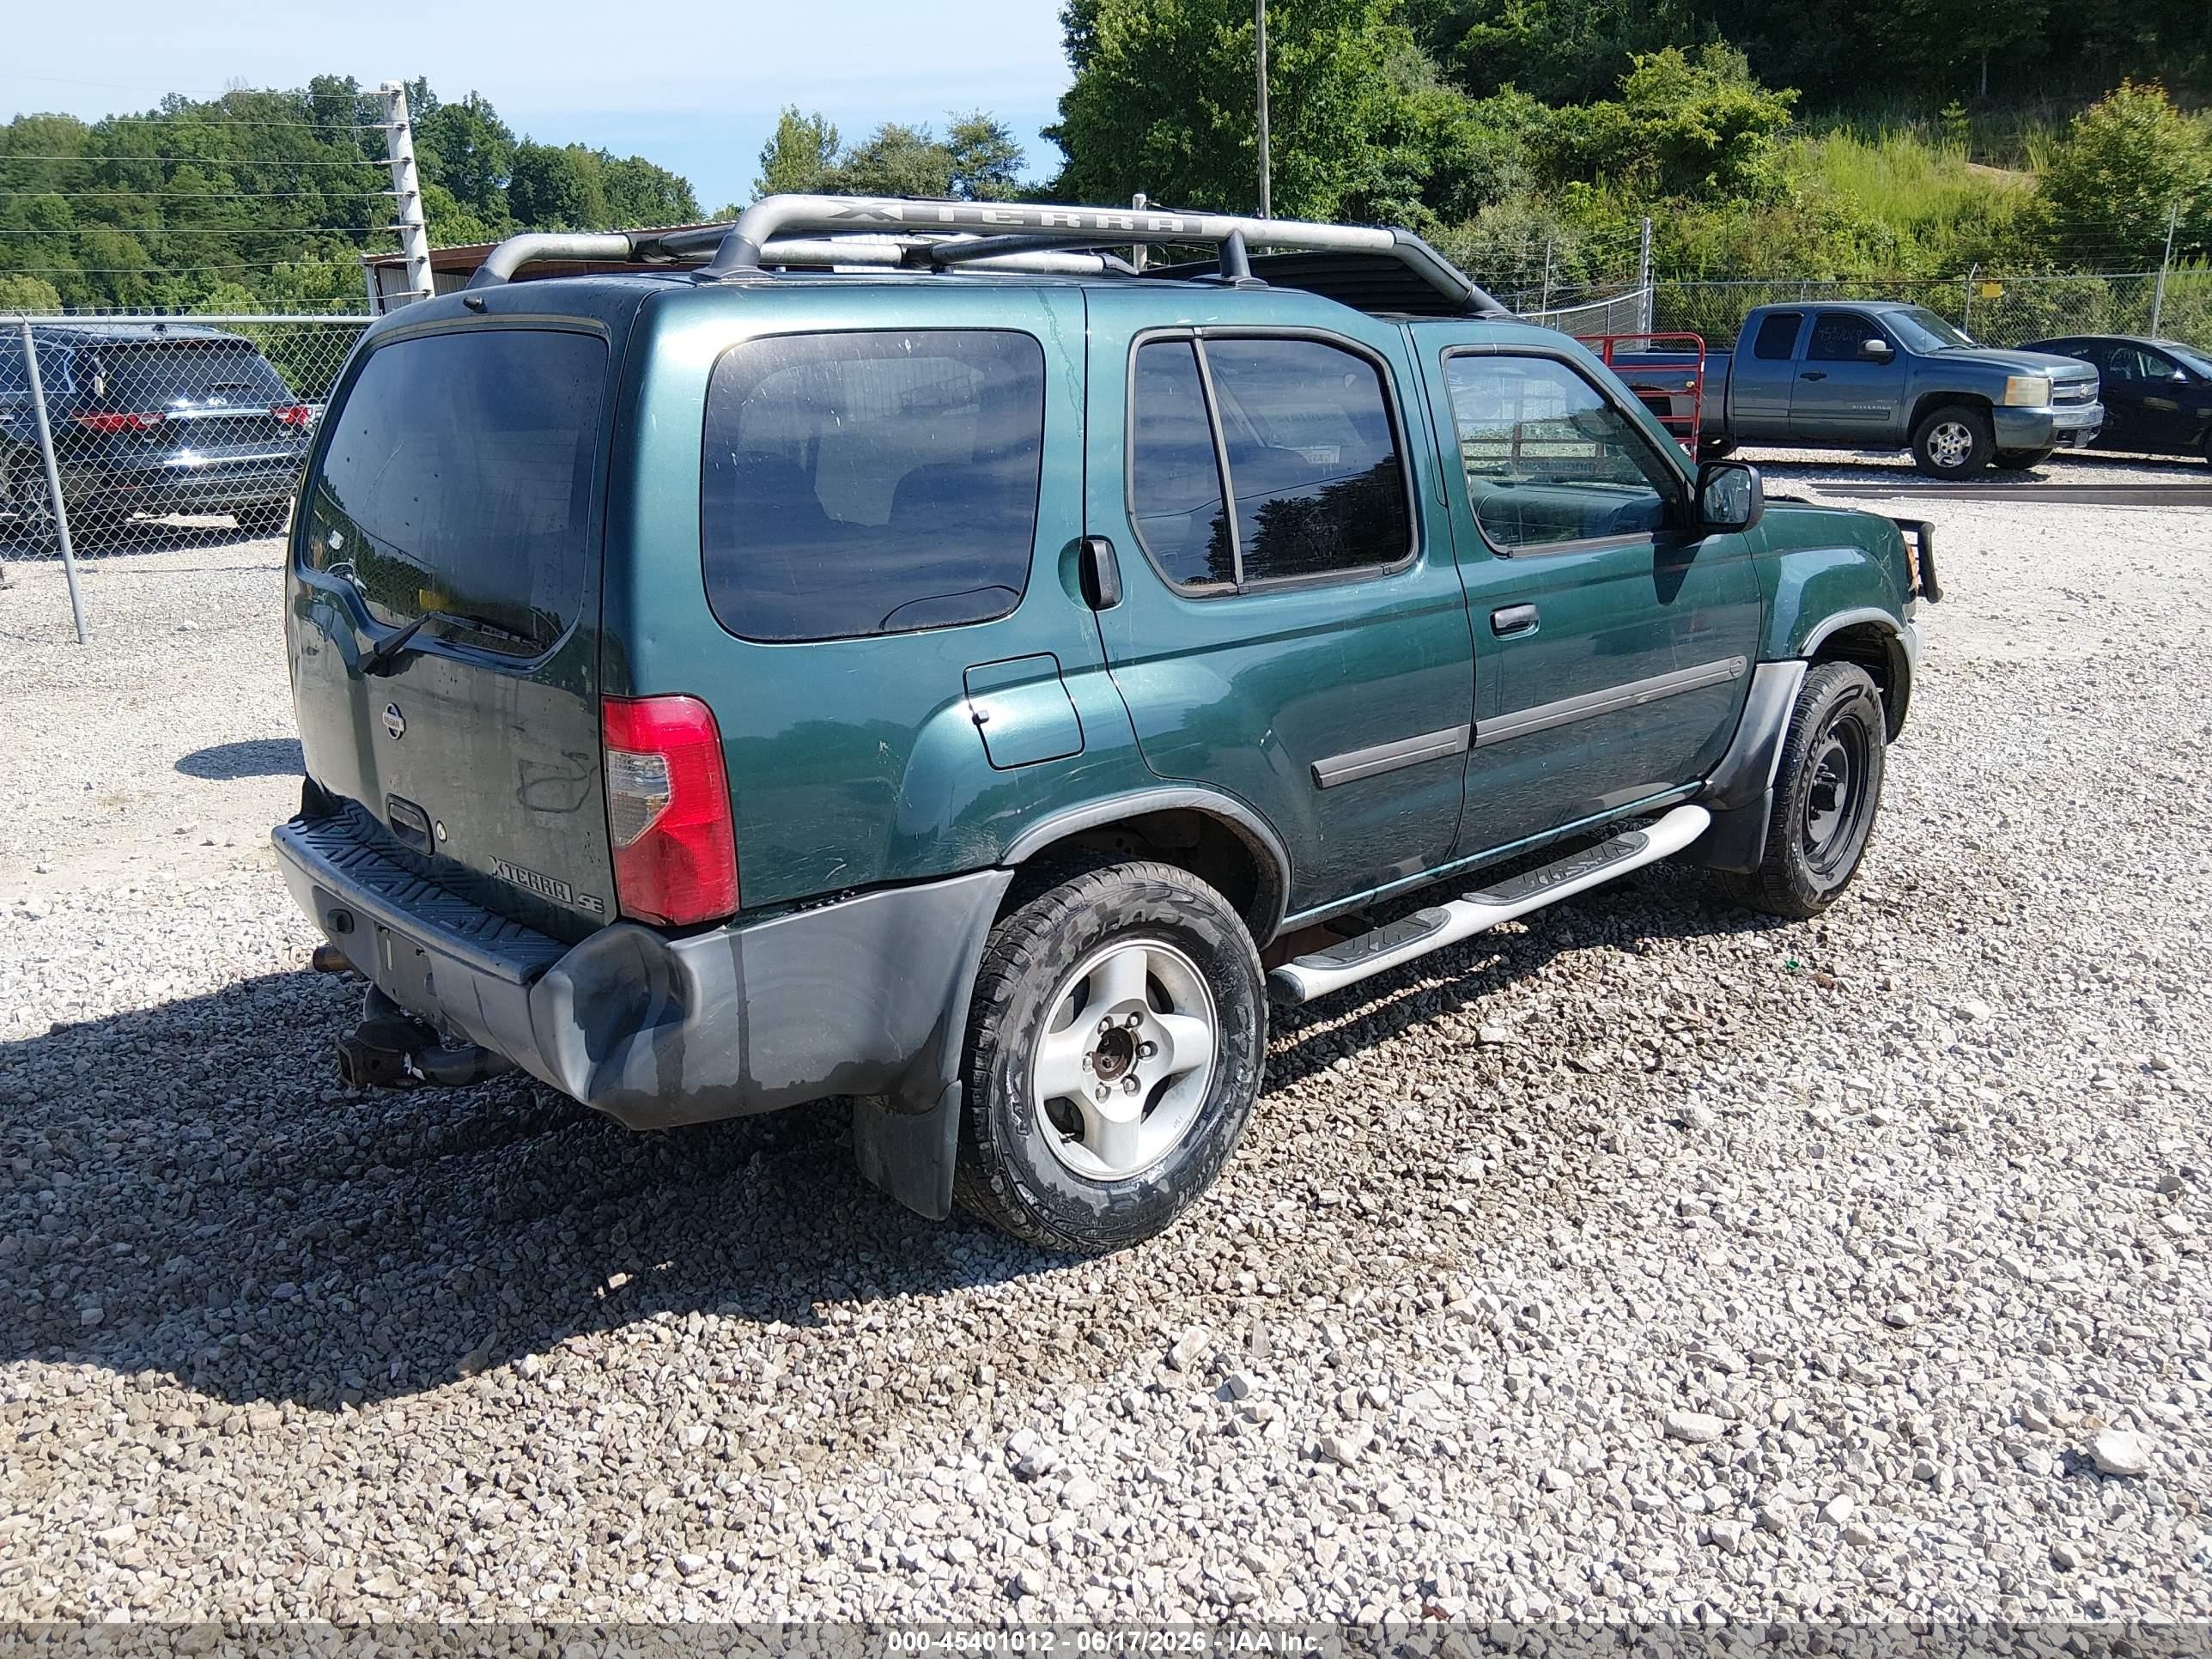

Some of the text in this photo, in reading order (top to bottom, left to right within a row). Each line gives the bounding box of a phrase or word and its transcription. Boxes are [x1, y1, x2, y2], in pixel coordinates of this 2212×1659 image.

[827, 201, 1186, 232] XTERRA
[489, 855, 605, 914] XTERRA SE
